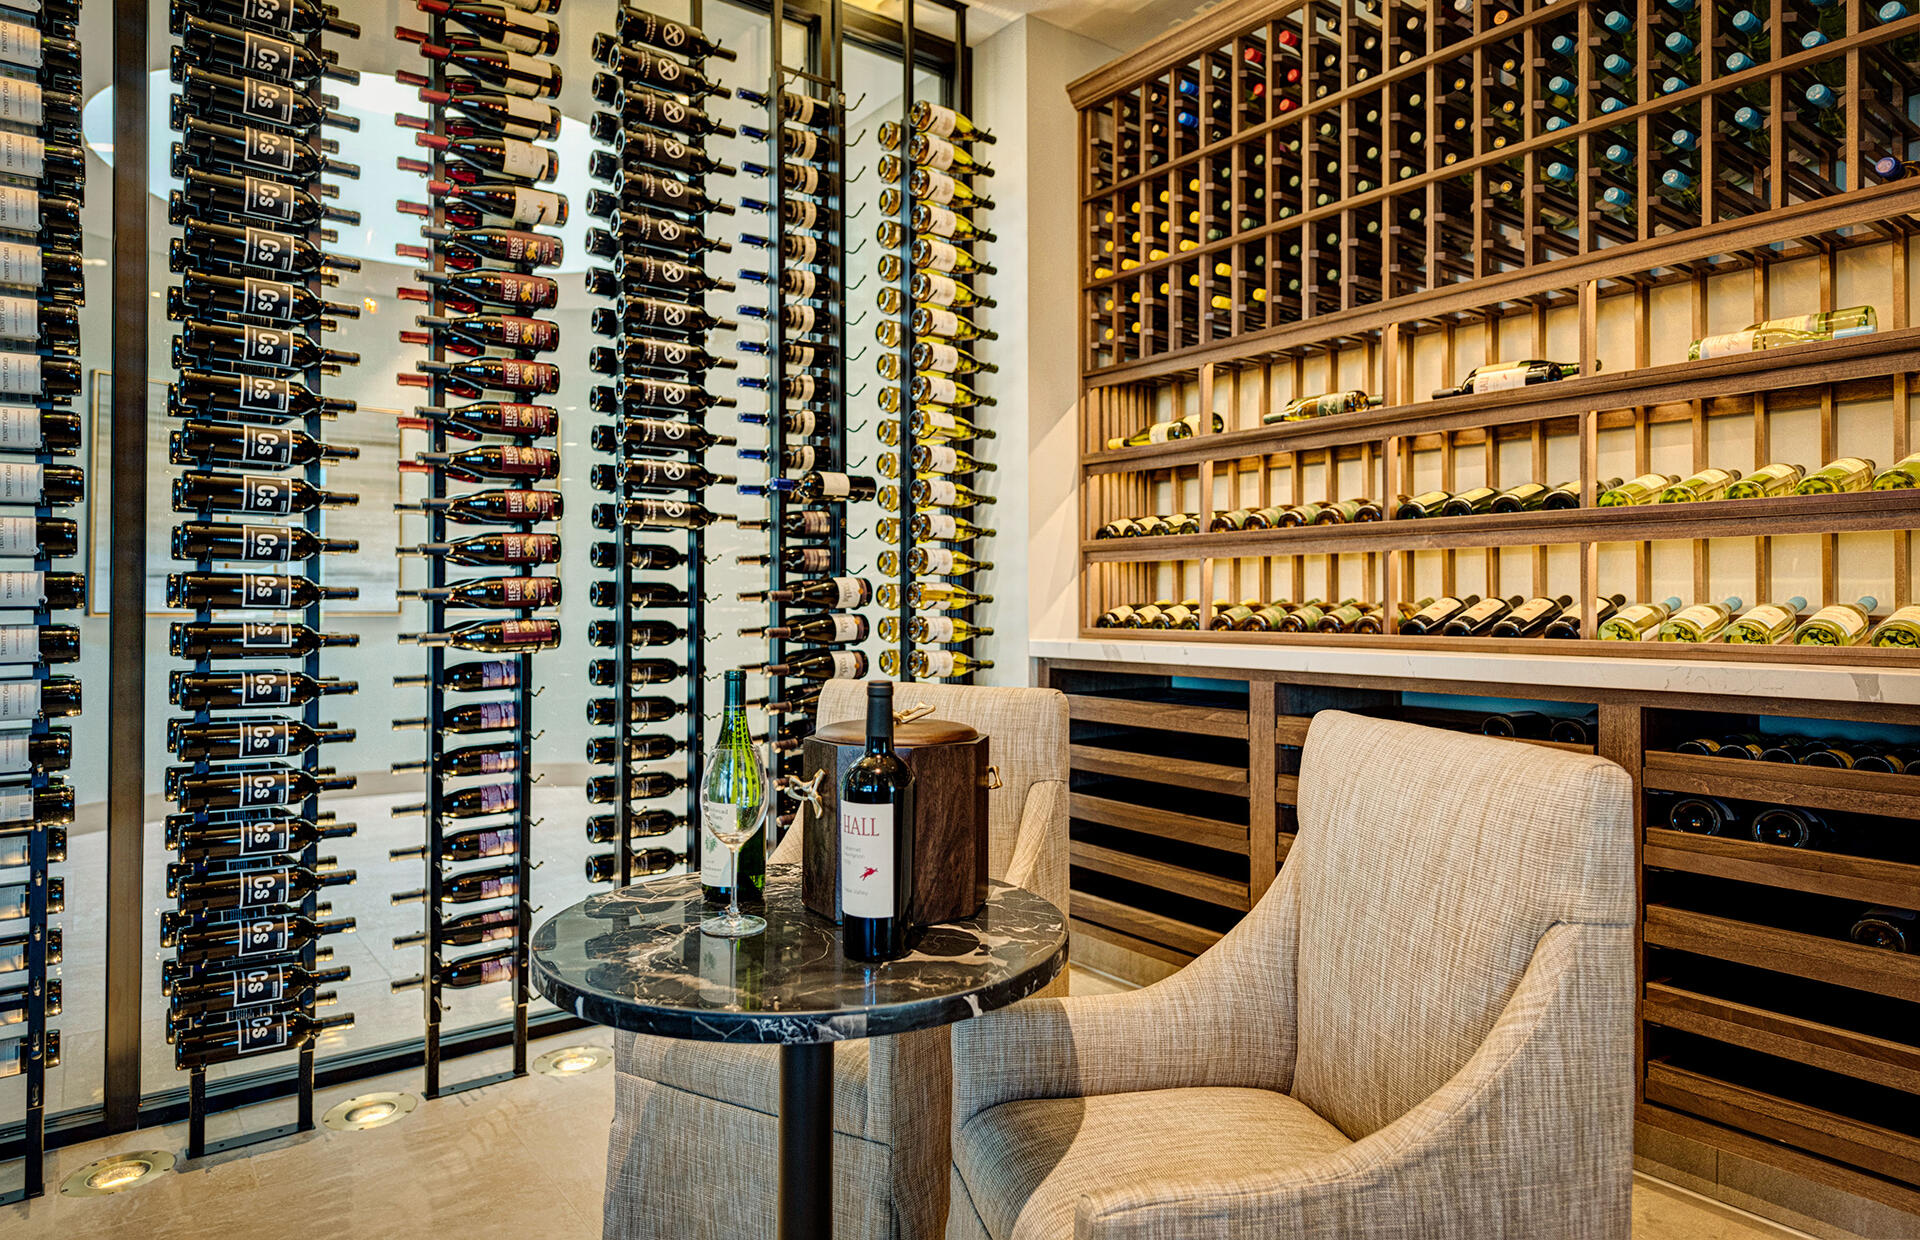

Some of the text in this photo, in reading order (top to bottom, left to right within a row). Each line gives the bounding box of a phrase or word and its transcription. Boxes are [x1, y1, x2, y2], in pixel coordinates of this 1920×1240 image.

[510, 237, 518, 259] HESS
[504, 278, 512, 300] HESS
[506, 321, 514, 344] HESS
[506, 362, 514, 384] HESS
[505, 405, 513, 426] HESS
[510, 492, 518, 512] HESS
[508, 536, 516, 558] HESS
[508, 580, 516, 602] HESS
[844, 814, 880, 836] HALL
